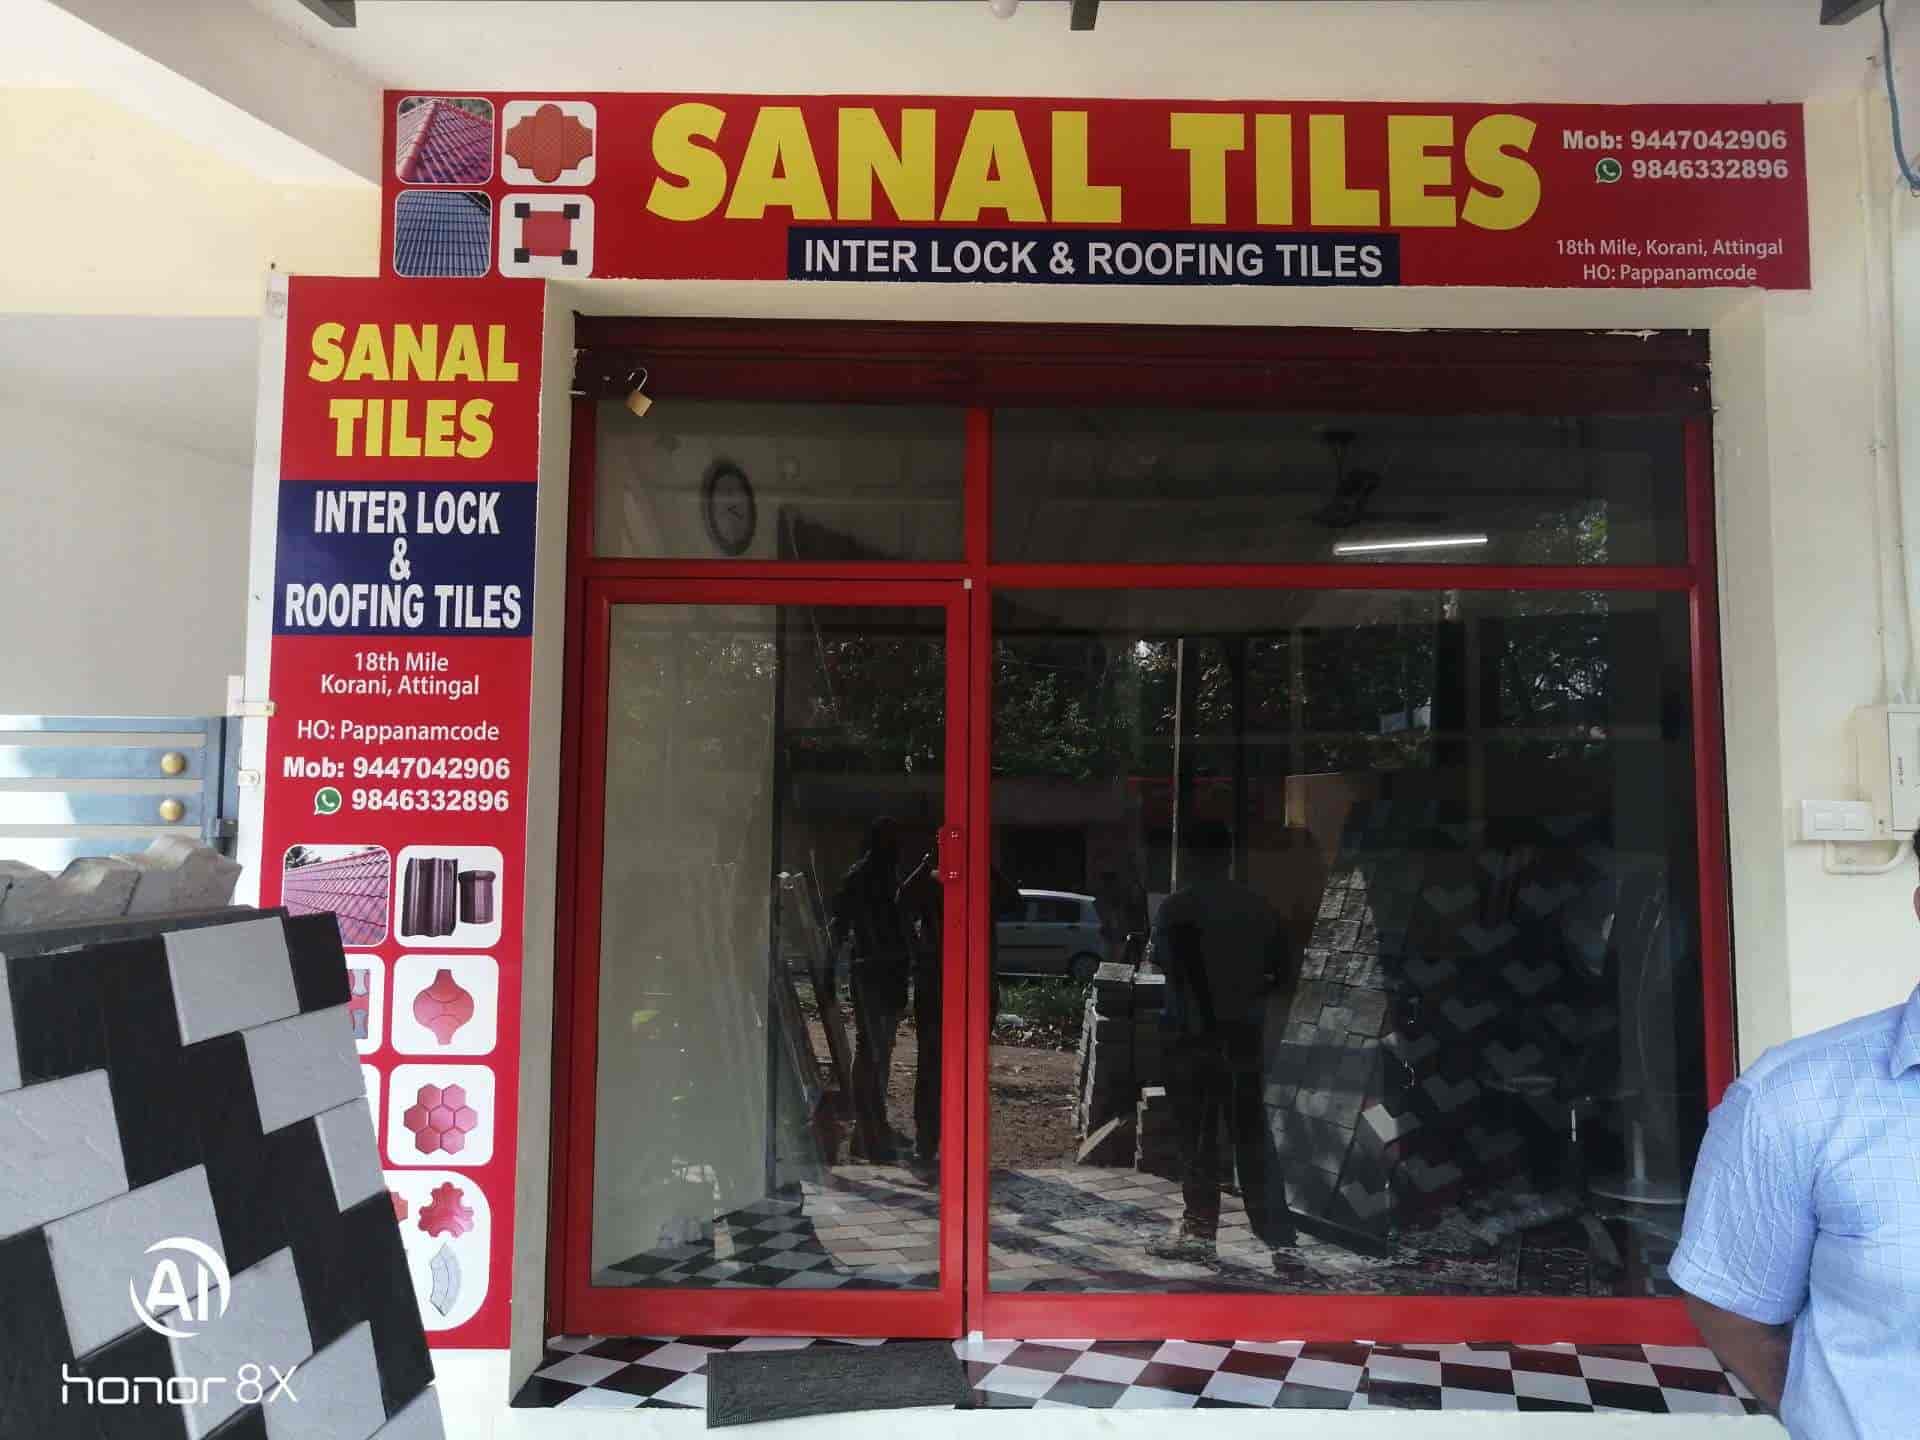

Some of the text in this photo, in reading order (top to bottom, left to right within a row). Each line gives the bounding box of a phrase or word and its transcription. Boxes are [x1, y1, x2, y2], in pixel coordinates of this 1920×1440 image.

[1562, 130, 1787, 150] Mob: 9447042906
[646, 102, 1541, 230] SANAL TILES
[1631, 159, 1788, 179] 9846332896
[804, 239, 1383, 278] INTER LOCK & ROOFING TILES
[1556, 239, 1783, 259] 18th Mile, Korani, Attingal
[1583, 264, 1757, 284] HO: Pappanamcode
[308, 322, 519, 382] SANAL
[329, 398, 494, 458] TILES
[314, 491, 500, 534] INTER LOCK
[389, 537, 411, 581] &
[285, 584, 522, 629] ROOFING TILES
[354, 652, 448, 672] 18th Mile
[321, 674, 479, 700] Korani, Attingal
[297, 719, 500, 744] HO: Pappanamcode
[283, 756, 510, 779] Mob: 9447042906
[352, 788, 509, 811] 9846332896
